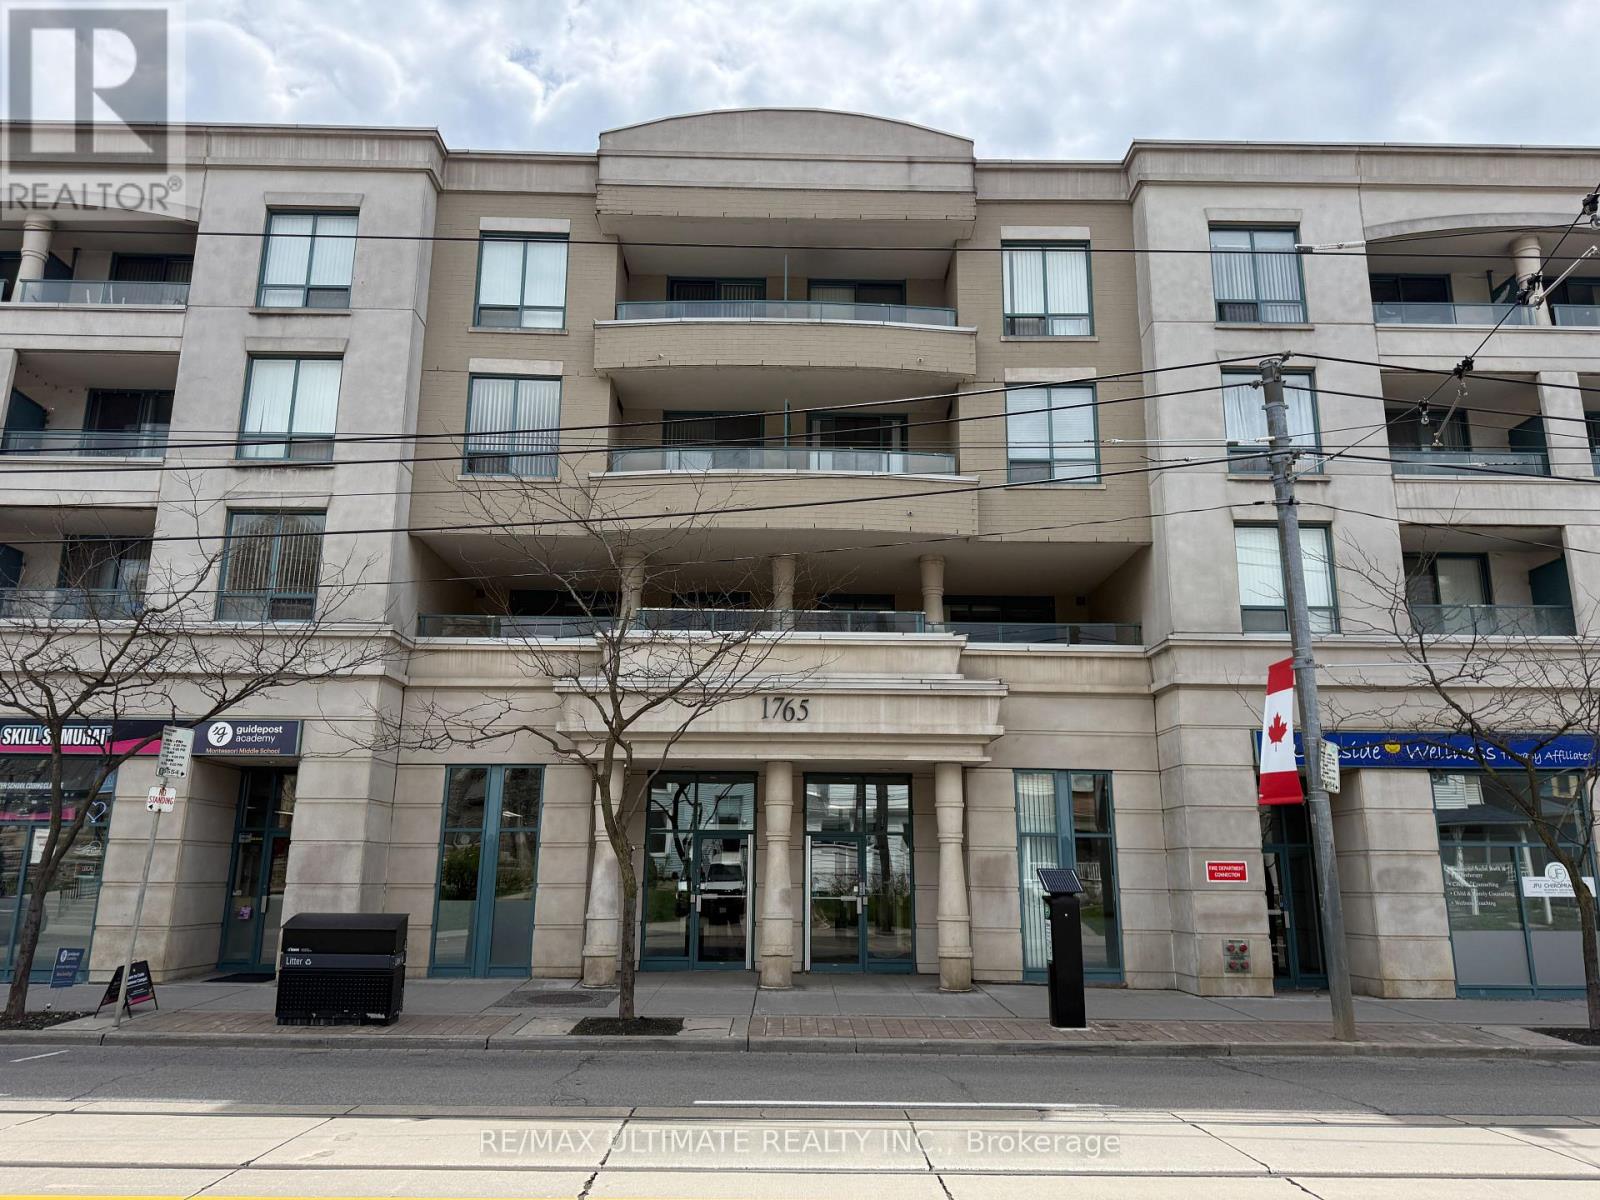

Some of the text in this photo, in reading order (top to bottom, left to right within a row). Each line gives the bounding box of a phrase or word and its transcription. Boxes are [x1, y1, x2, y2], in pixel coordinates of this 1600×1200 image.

[761, 696, 810, 722] 1765
[236, 725, 283, 735] guidepost
[2, 728, 106, 745] SKILL SMURAI
[235, 734, 276, 744] academy
[159, 788, 167, 796] NO
[149, 796, 174, 805] STANDING
[286, 957, 303, 966] Litter
